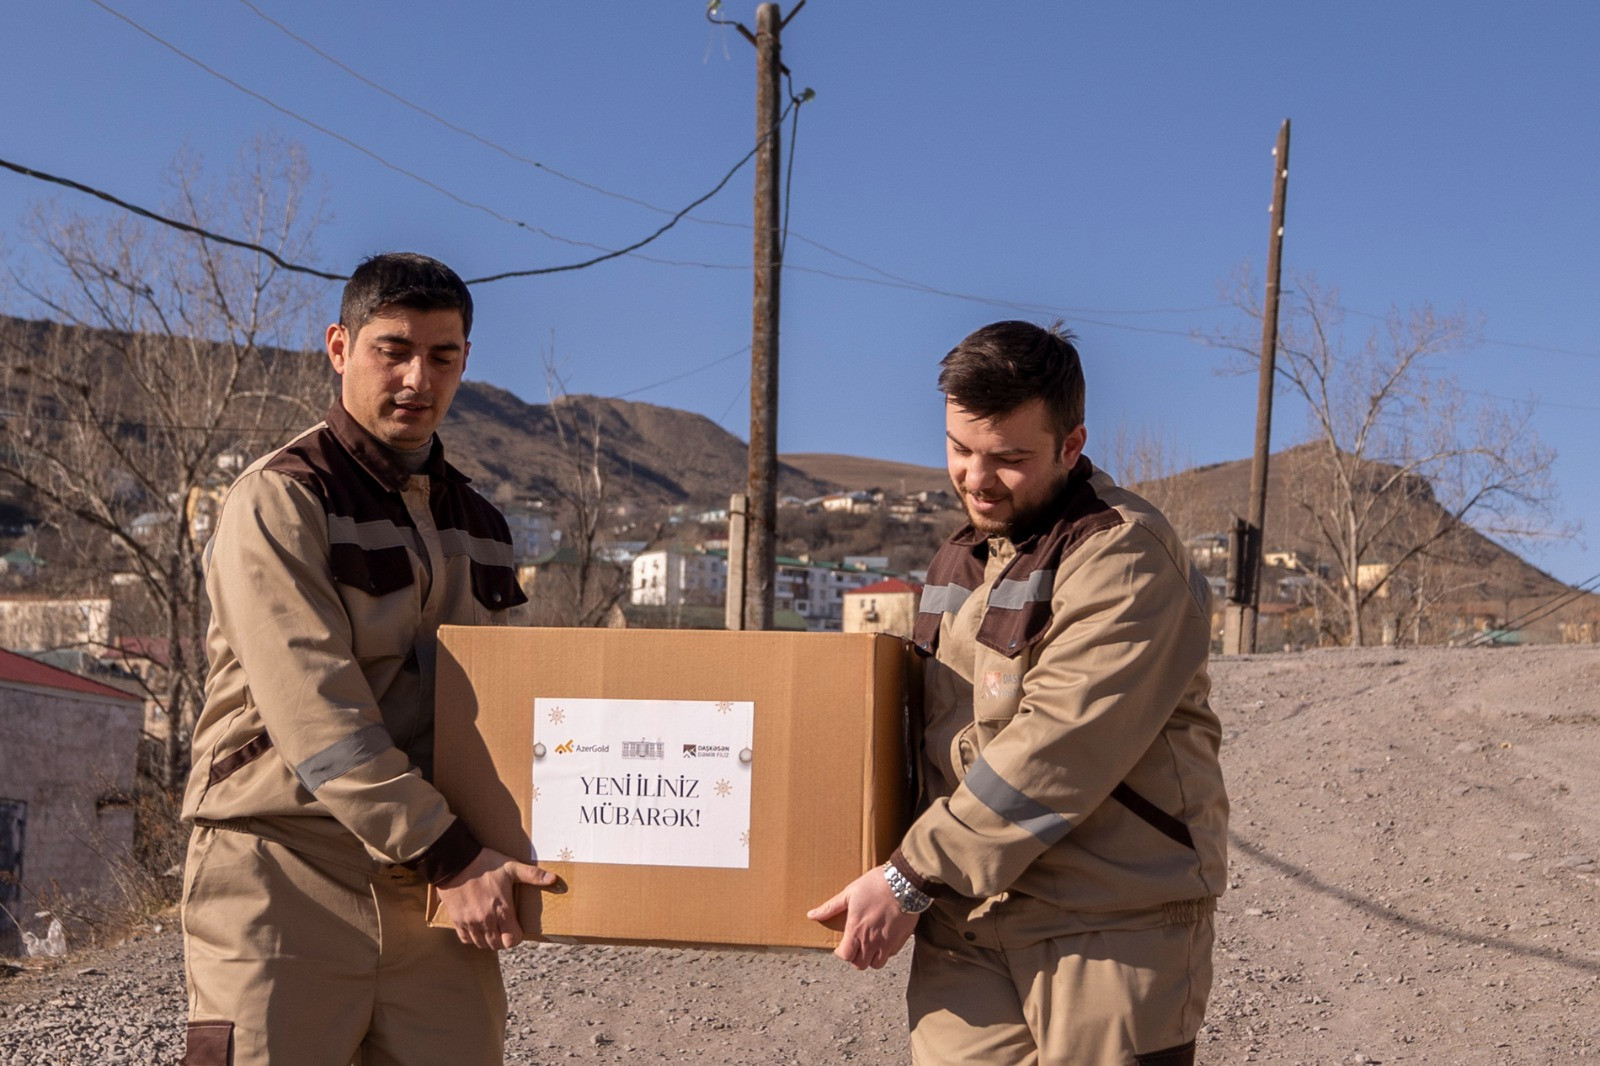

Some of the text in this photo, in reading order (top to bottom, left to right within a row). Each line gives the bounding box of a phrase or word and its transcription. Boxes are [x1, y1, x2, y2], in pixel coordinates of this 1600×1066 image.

[576, 744, 609, 753] AzerGold
[580, 773, 700, 798] YENİ İLİNİZ
[579, 802, 701, 827] MÜBARƏK!
